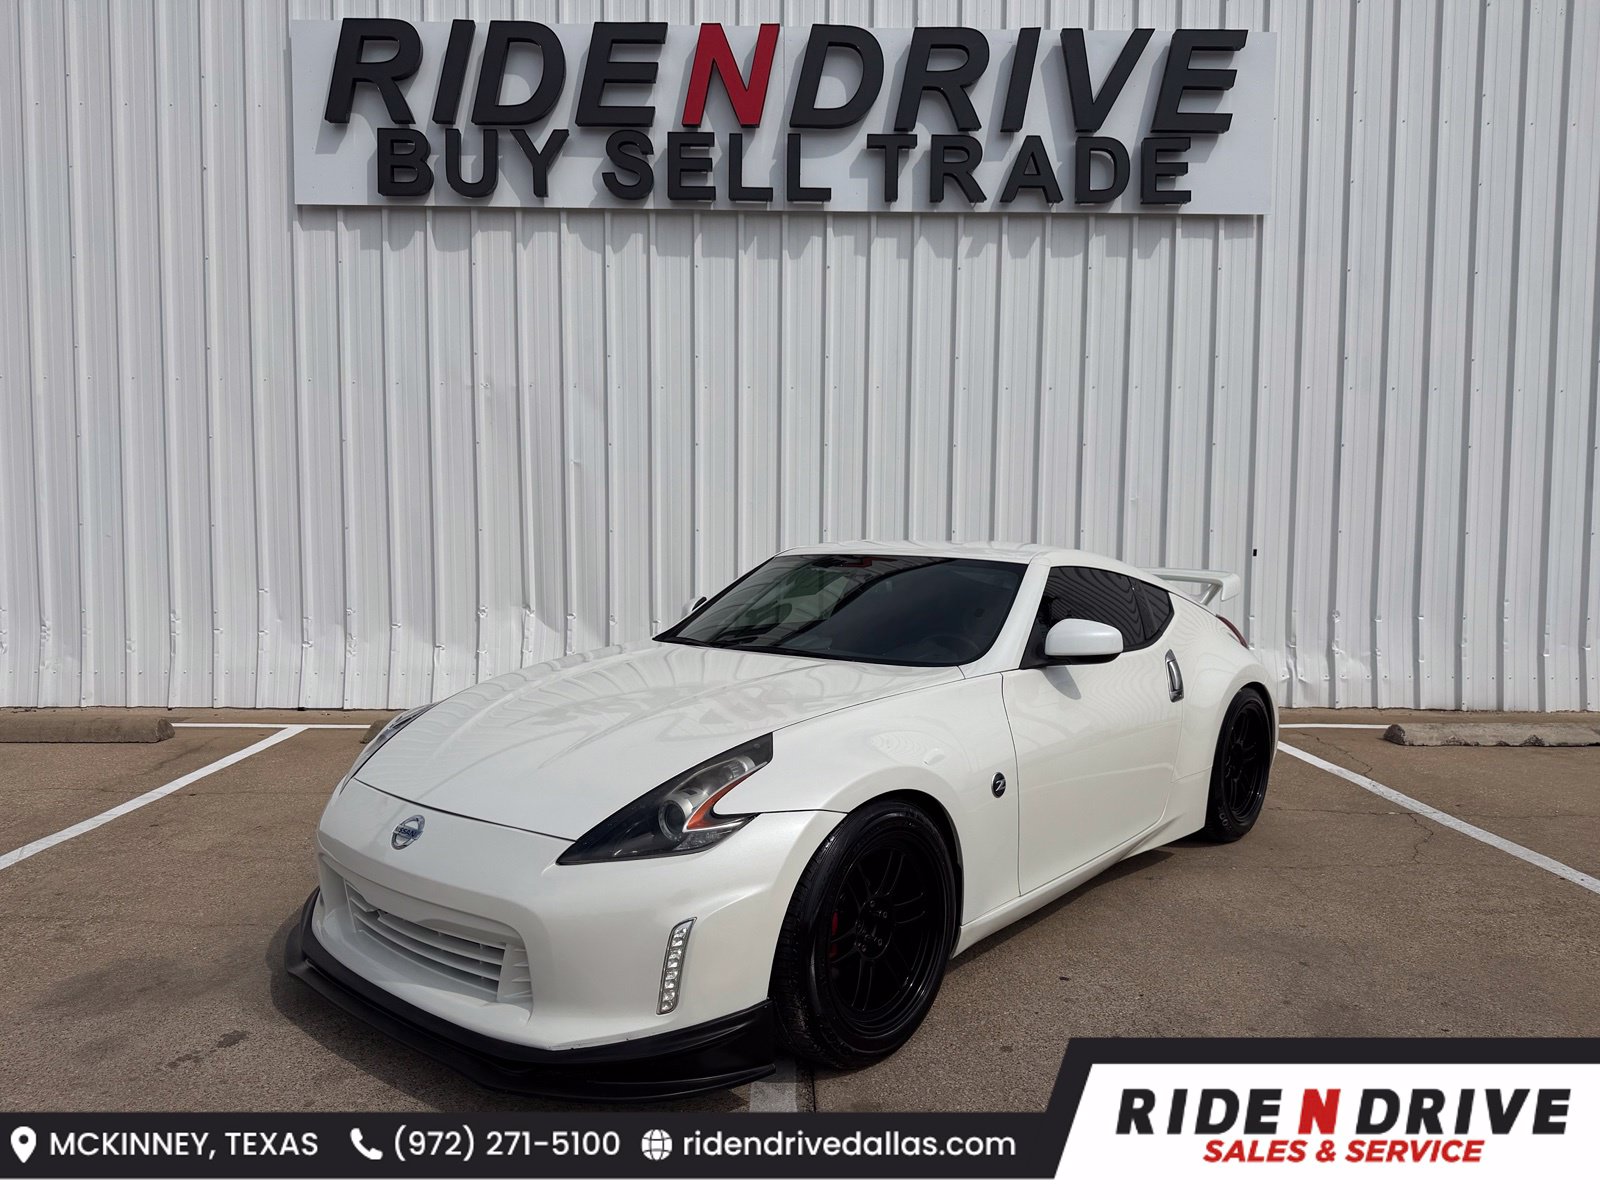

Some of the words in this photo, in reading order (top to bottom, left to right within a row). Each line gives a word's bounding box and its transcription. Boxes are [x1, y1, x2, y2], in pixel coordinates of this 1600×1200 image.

[377, 127, 569, 198] BUY
[602, 130, 832, 203] SELL
[867, 133, 1192, 205] TRADE
